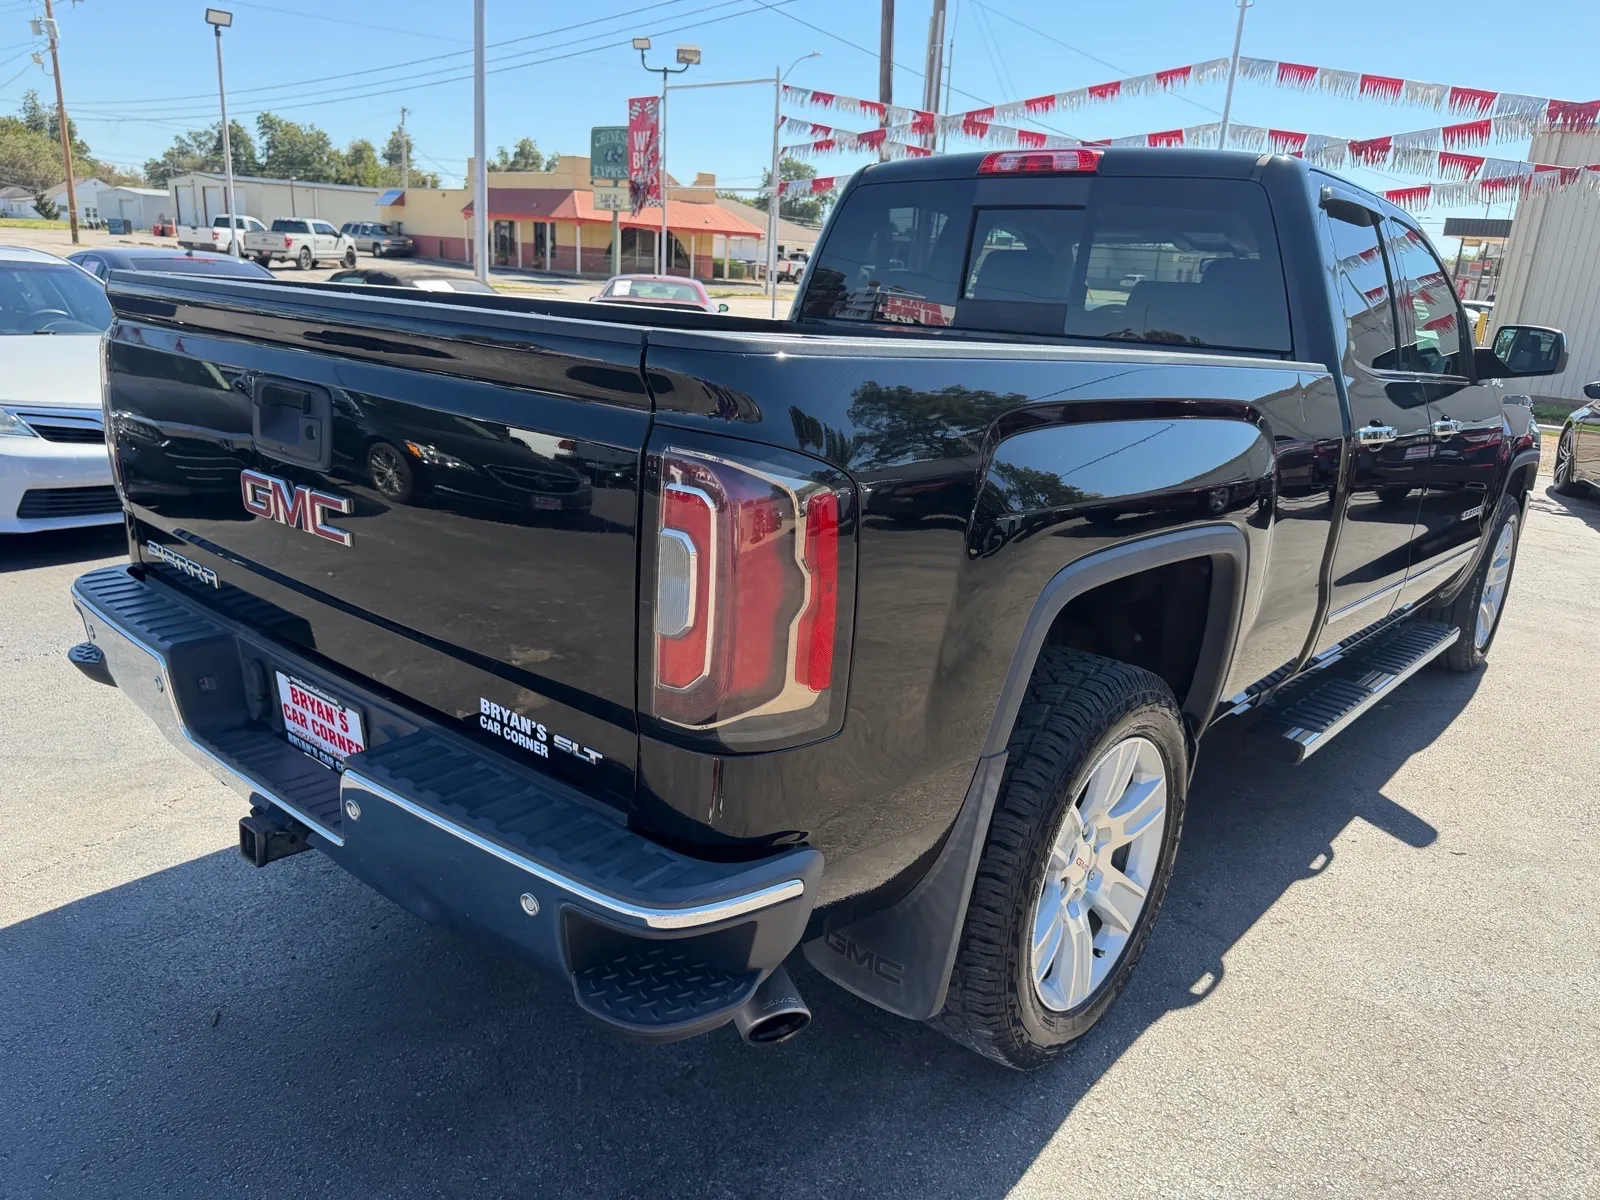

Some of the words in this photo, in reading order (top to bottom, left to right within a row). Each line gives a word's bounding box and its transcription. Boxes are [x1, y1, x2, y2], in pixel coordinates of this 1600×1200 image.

[595, 130, 629, 148] CHINES
[593, 164, 629, 178] EXPRES
[240, 468, 354, 548] GMC
[147, 540, 221, 589] SIERRA
[283, 703, 309, 731] CAR
[290, 685, 349, 733] BRYAN'S
[480, 697, 547, 742] BRYAN'S
[479, 715, 502, 736] CAR
[503, 726, 549, 759] CORNER
[553, 734, 603, 766] SLT
[825, 930, 904, 986] GMC
